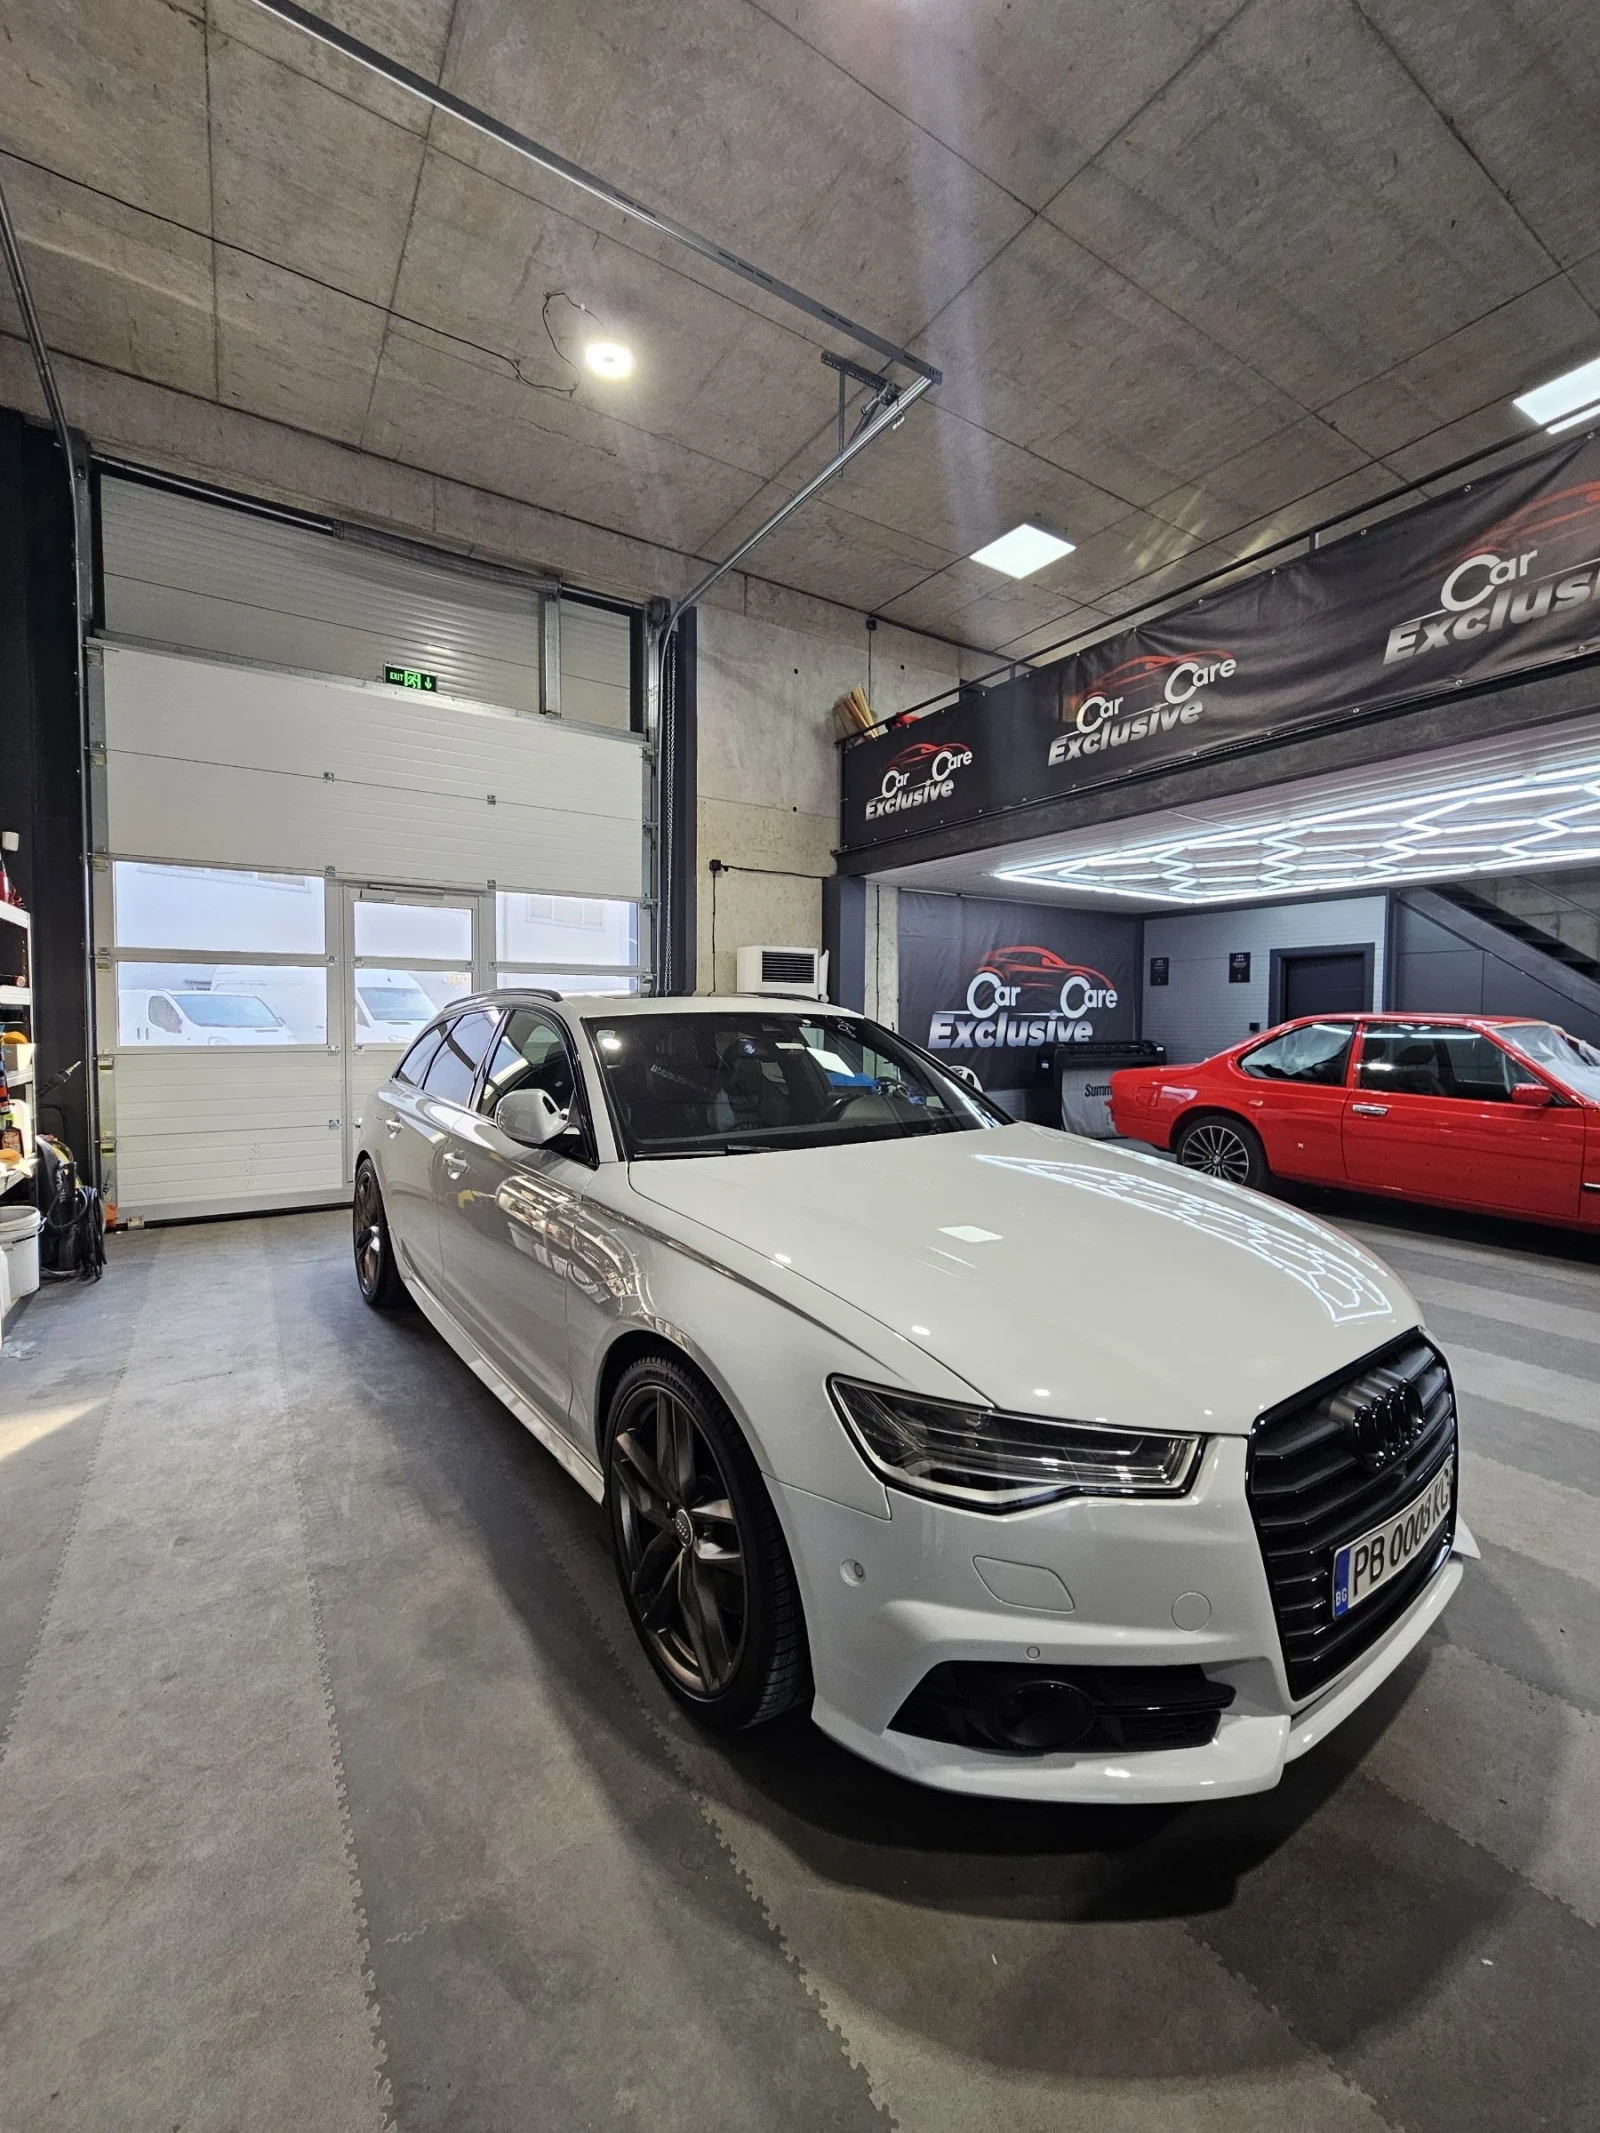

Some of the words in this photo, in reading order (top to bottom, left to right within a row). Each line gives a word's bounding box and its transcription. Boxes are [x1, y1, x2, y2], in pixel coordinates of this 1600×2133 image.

[1441, 550, 1537, 612] Car
[390, 671, 404, 681] EXIT
[1076, 696, 1124, 734] Car
[1164, 658, 1237, 704] Care
[1048, 700, 1203, 766] Exclusive
[882, 769, 910, 798] Car
[932, 751, 973, 781] Care
[866, 779, 954, 820] Exclusive
[966, 972, 1021, 1019] Car
[1060, 976, 1118, 1019] Care
[928, 1012, 1093, 1049] Exclusive
[1354, 1535, 1385, 1597] PB
[1335, 1588, 1348, 1607] BG
